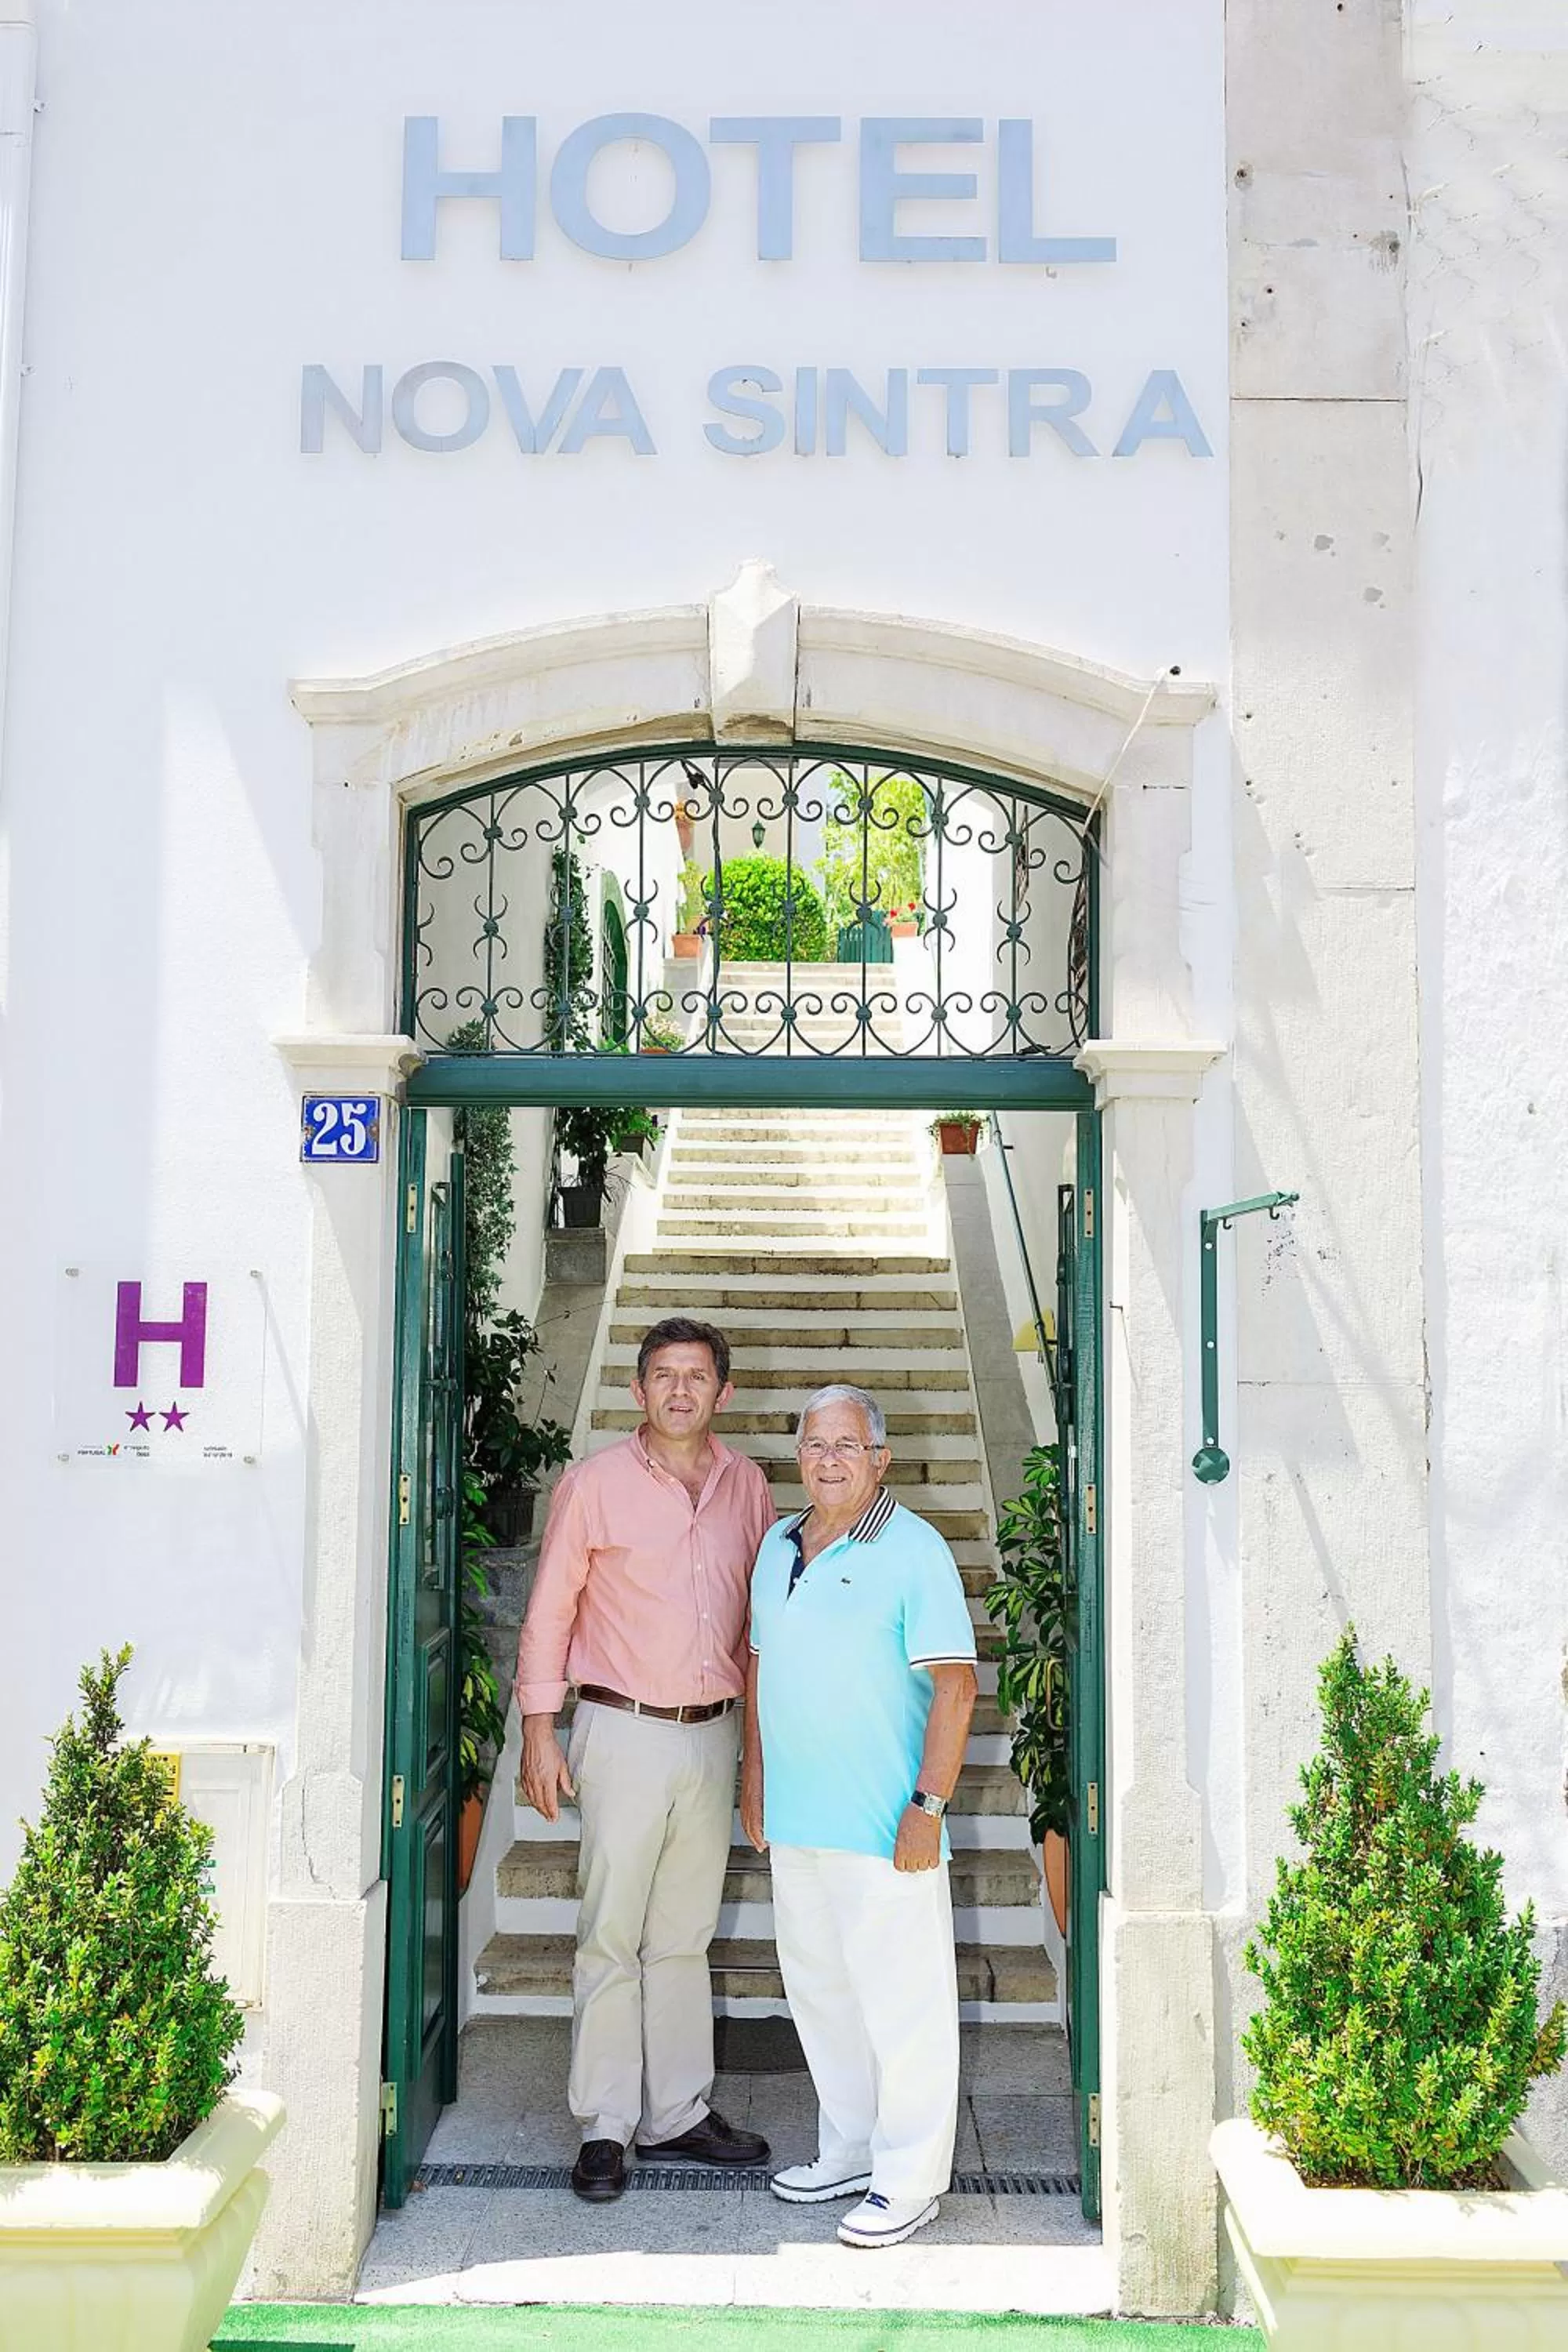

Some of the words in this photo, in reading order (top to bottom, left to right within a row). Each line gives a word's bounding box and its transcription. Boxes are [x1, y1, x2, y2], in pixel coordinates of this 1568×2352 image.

[401, 111, 1117, 264] HOTEL
[299, 360, 658, 456] NOVA
[702, 363, 1215, 459] SINTRA
[311, 1102, 366, 1155] 25
[114, 1281, 207, 1388] H
